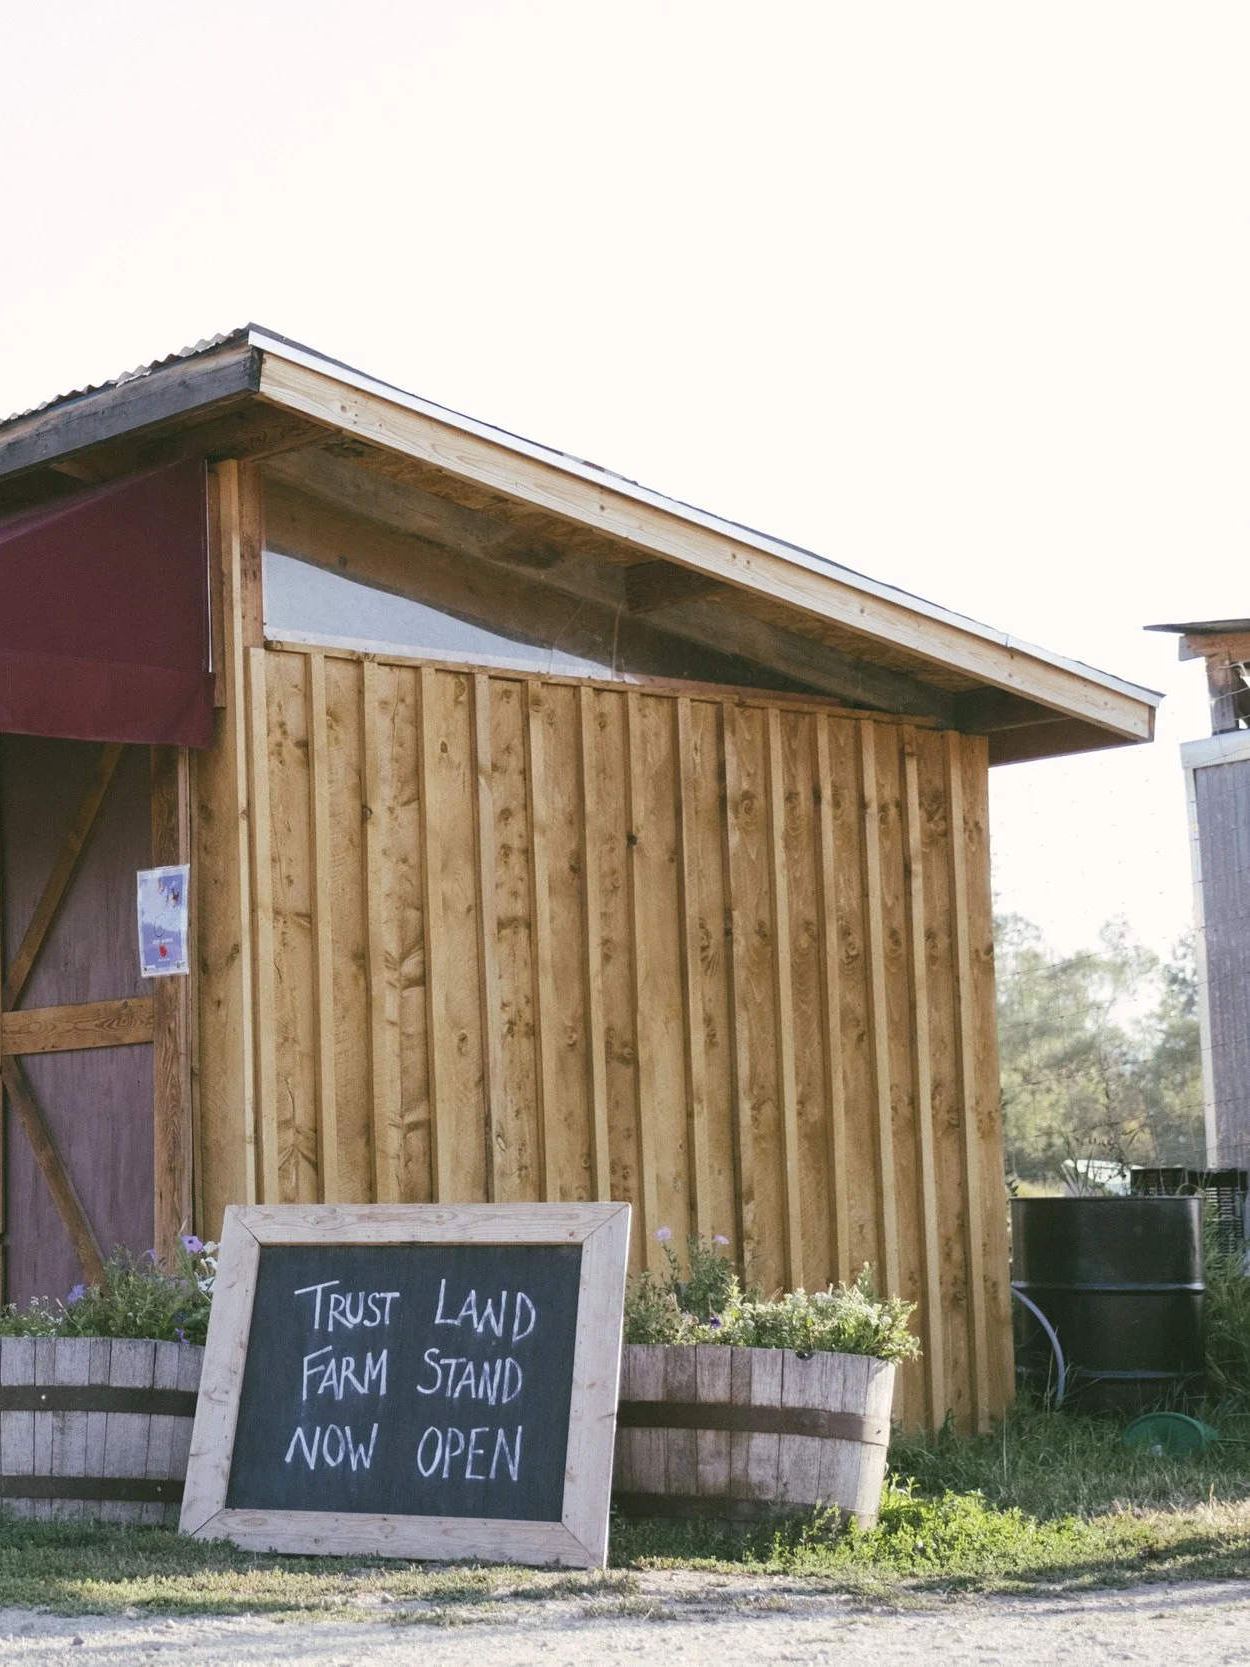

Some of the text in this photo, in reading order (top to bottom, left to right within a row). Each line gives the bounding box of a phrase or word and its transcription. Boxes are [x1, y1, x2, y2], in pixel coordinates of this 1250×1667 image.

[294, 1278, 537, 1342] TRUST LAND
[302, 1344, 523, 1405] FARM STAND
[284, 1422, 523, 1482] NOW OPEN
